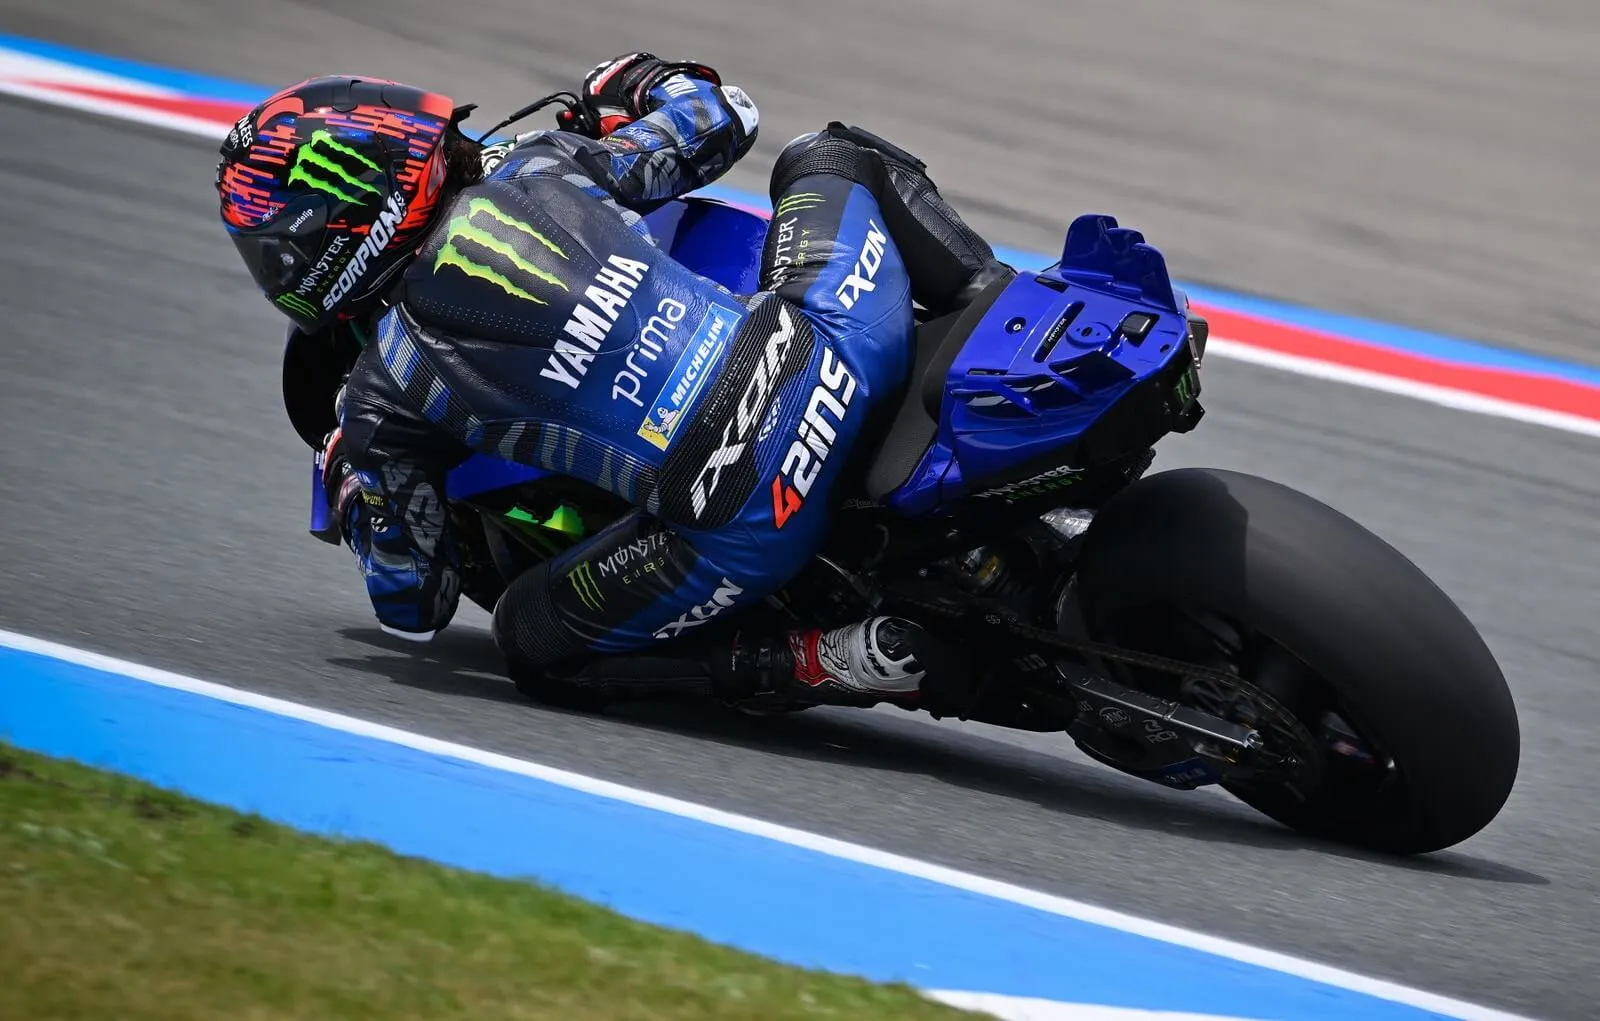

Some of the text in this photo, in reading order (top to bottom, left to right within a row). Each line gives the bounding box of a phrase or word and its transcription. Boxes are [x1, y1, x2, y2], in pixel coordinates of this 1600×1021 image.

[289, 207, 313, 233] gudslip
[296, 234, 350, 296] MONSTER
[322, 195, 403, 311] SCORPION
[539, 254, 650, 390] YAMAHA
[612, 297, 687, 407] prima
[670, 316, 725, 407] MICHELIN
